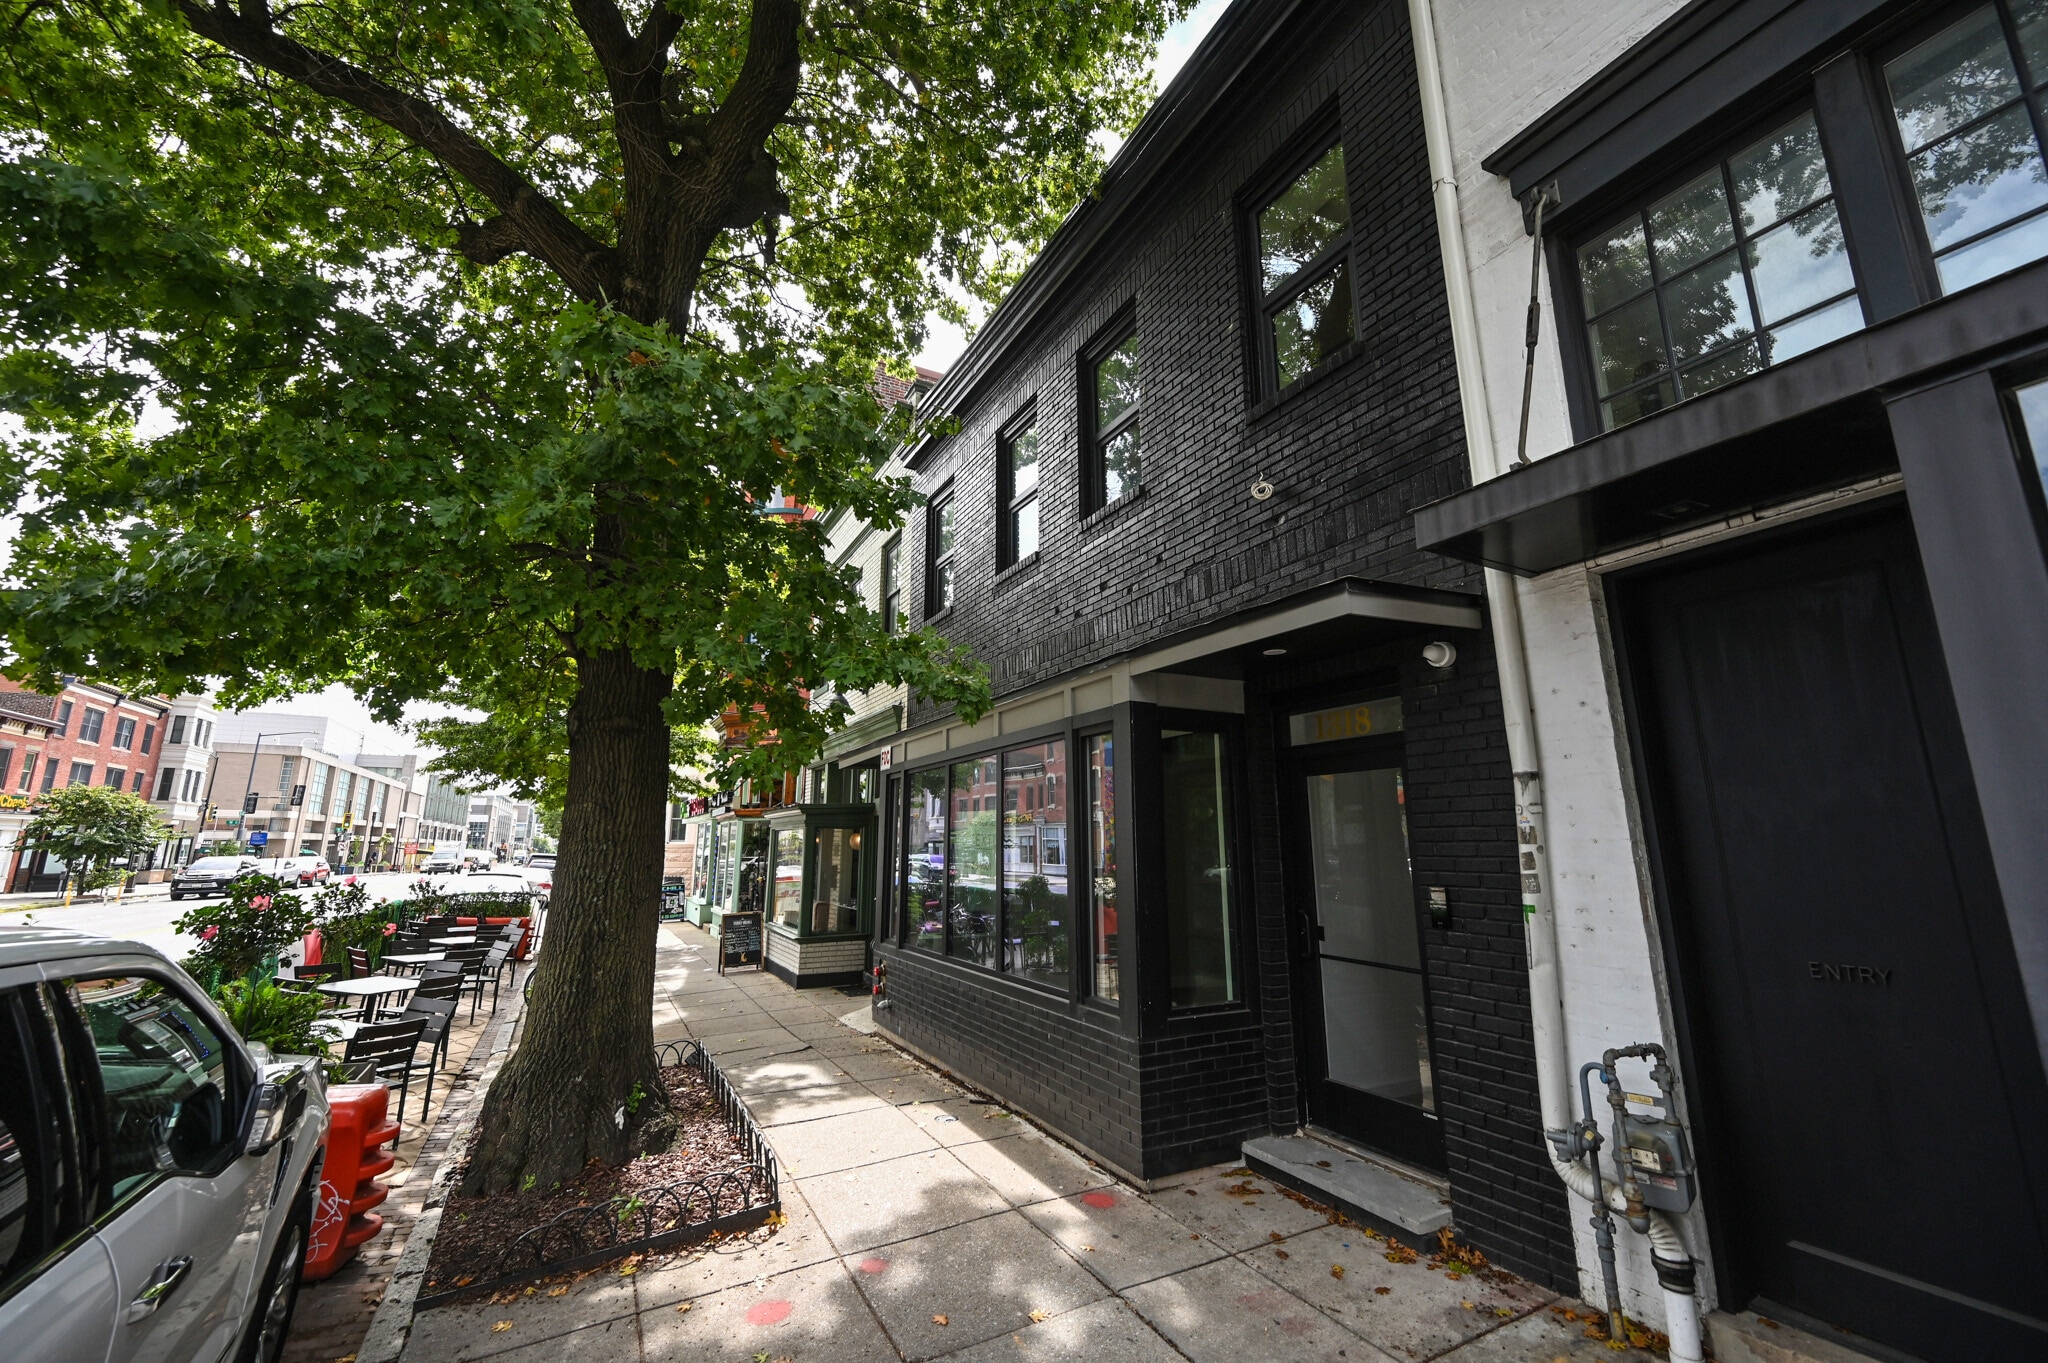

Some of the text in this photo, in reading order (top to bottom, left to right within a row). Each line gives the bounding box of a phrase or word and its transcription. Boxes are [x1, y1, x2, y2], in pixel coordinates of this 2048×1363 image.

[1314, 706, 1372, 740] 1318
[881, 750, 890, 766] FDC
[0, 794, 28, 809] Cbank
[1807, 961, 1890, 986] ENTRY
